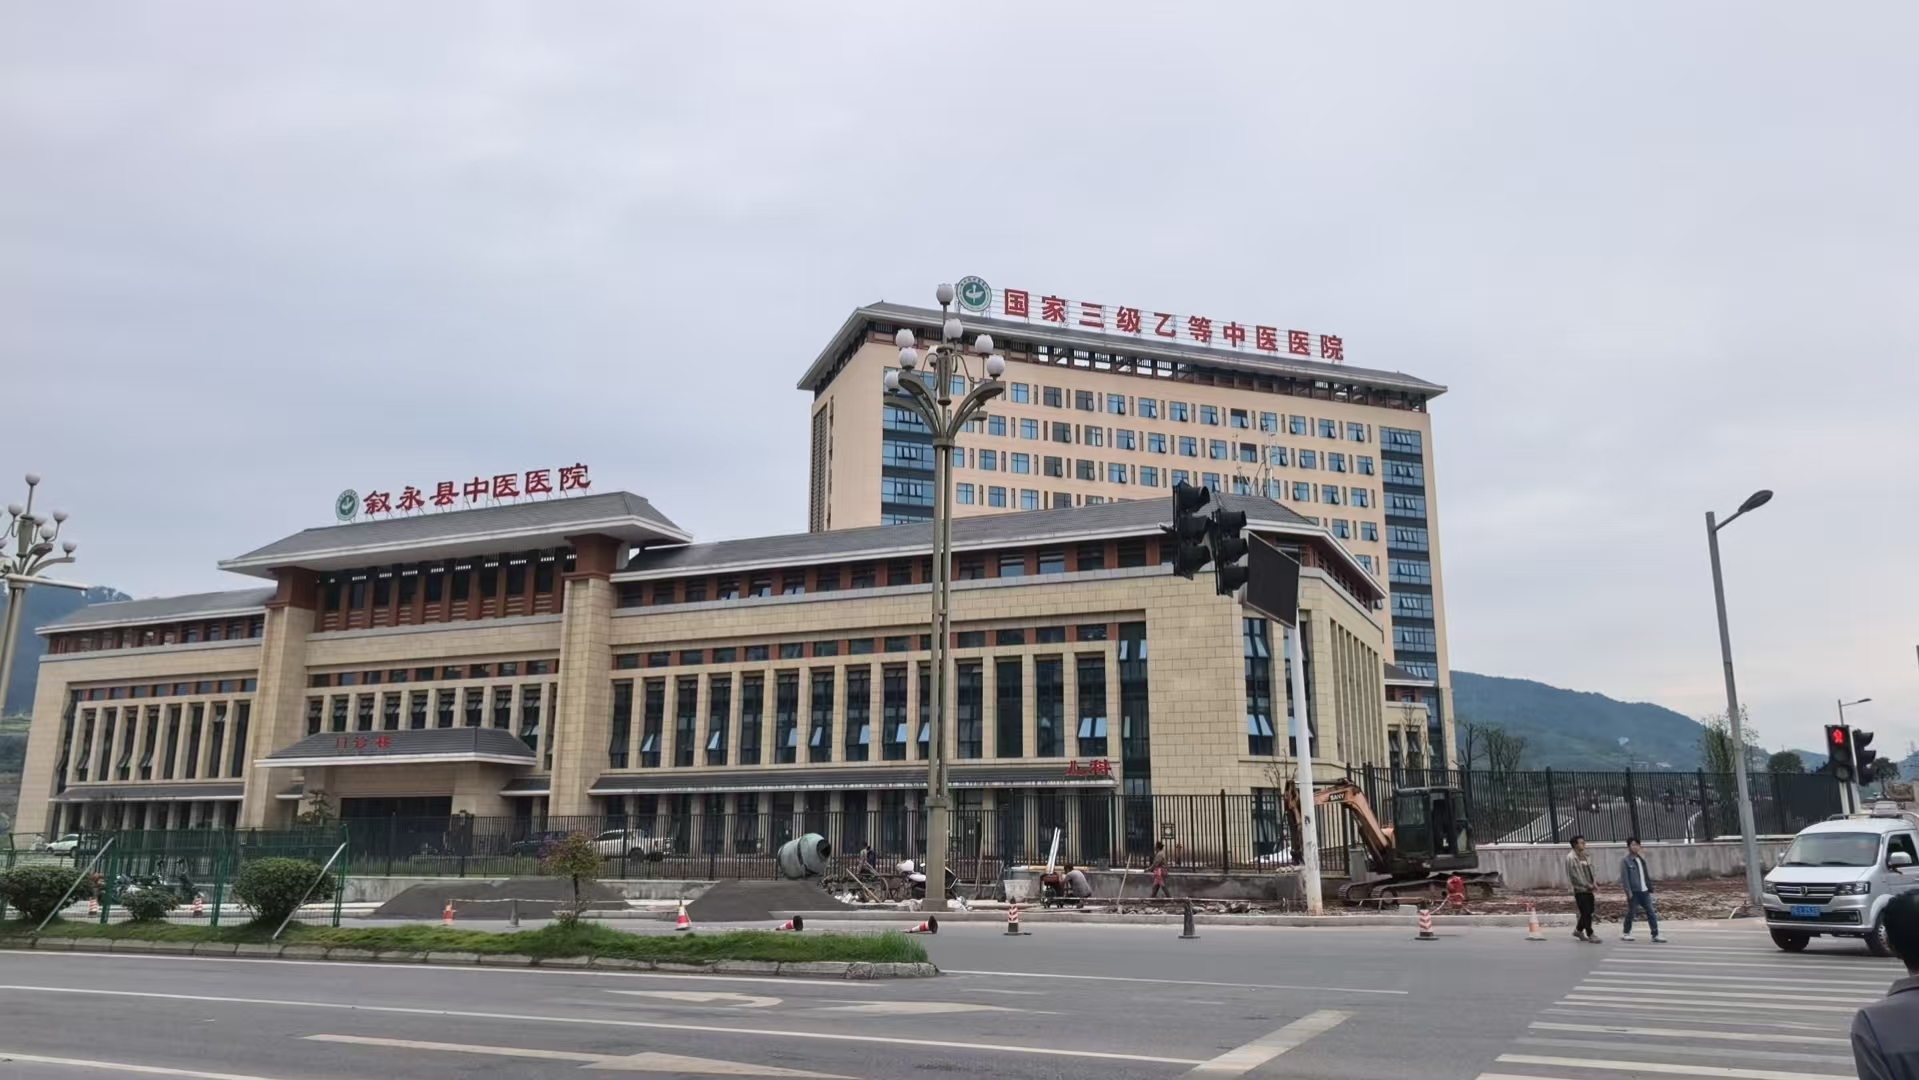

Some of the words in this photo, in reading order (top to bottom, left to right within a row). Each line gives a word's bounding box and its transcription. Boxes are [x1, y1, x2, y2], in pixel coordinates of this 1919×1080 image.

[1004, 288, 1344, 361] 国家三级乙等中医医院
[363, 462, 592, 515] 叙永县中医医院
[1064, 759, 1112, 776] 儿科
